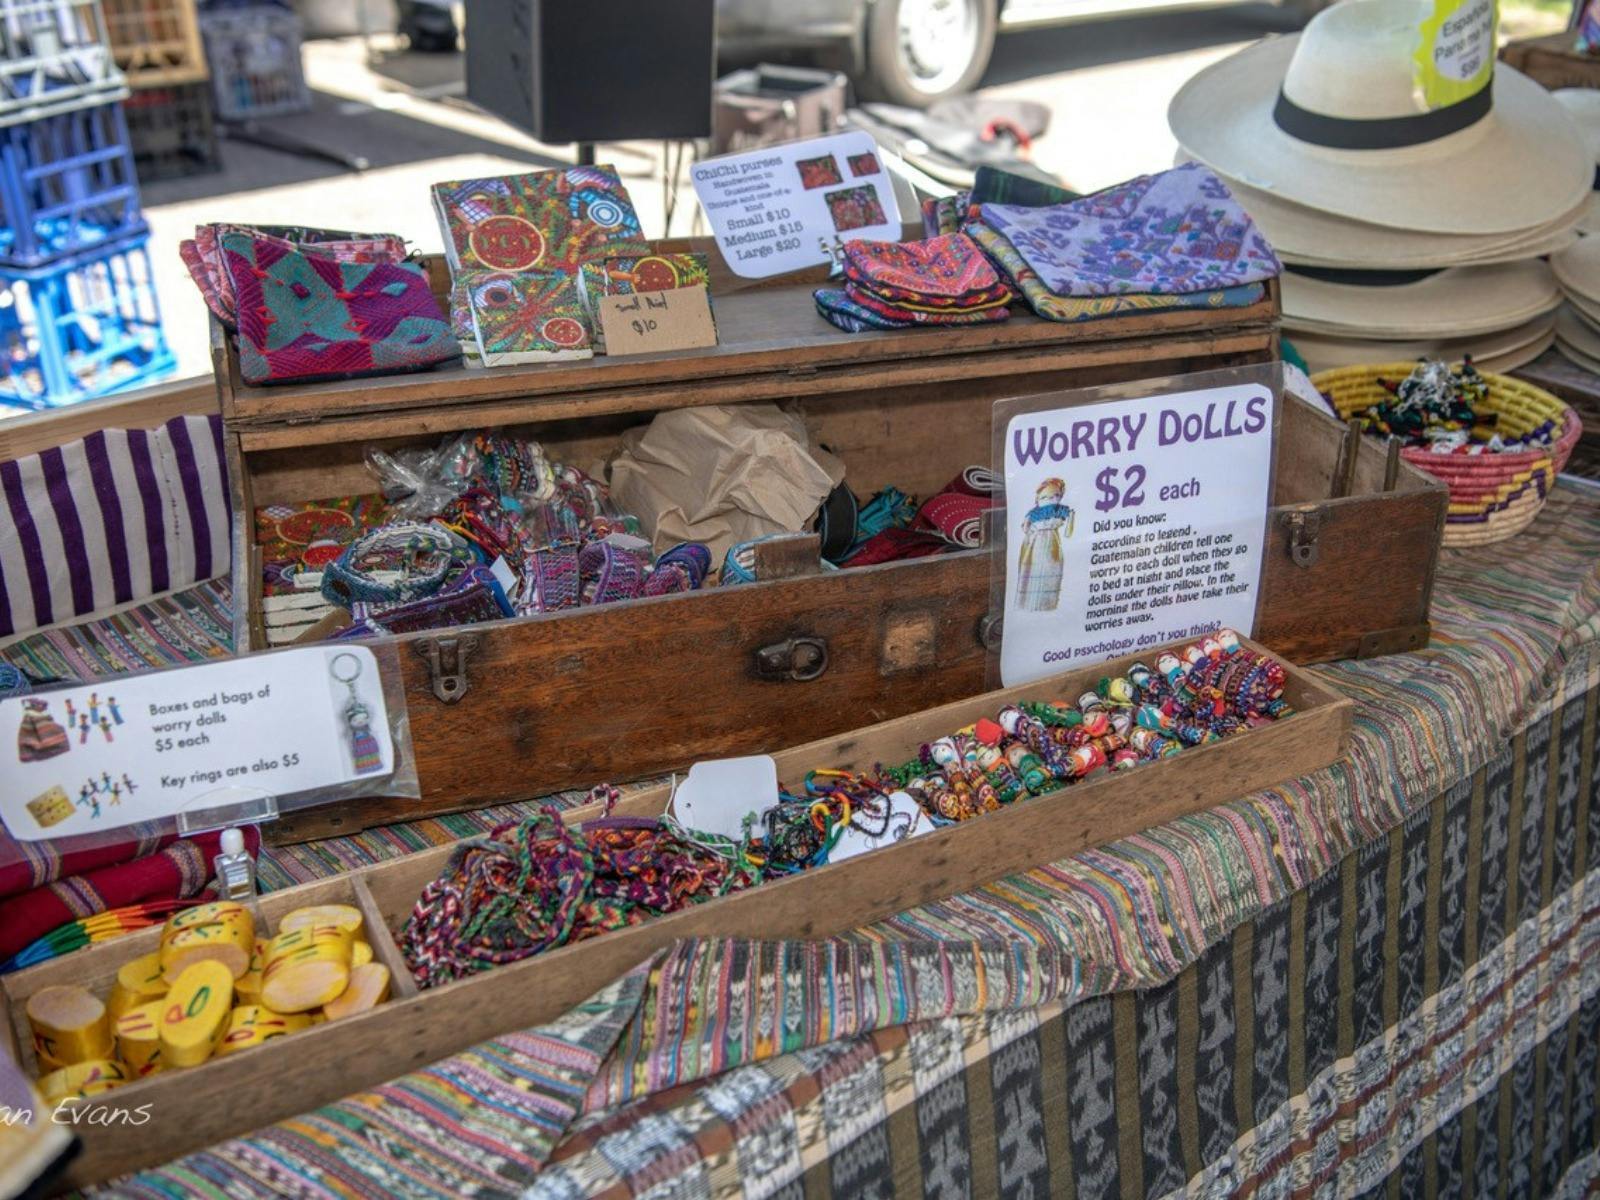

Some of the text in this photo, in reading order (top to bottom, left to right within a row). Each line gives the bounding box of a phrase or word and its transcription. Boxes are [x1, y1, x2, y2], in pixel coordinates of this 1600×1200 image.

[696, 156, 783, 181] ChiChi purses
[724, 183, 770, 196] Guatemala
[740, 194, 756, 204] and
[726, 208, 790, 230] Small $10
[744, 202, 765, 212] kind
[723, 220, 804, 247] Medium $15
[736, 237, 801, 260] Large $20
[1094, 464, 1200, 512] $2 each
[1093, 512, 1166, 534] Did you know:
[1090, 533, 1233, 565] Guatemalan children tell one
[1092, 533, 1142, 552] according
[1144, 530, 1155, 542] to
[1090, 544, 1248, 579] worry to each doll when they go
[1088, 572, 1236, 606] dolls under their pillow. In the
[1089, 560, 1230, 593] to bed at night and place the
[1086, 582, 1250, 620] morning the dolls have take their
[1085, 612, 1154, 632] worries away.
[1042, 647, 1071, 663] Good
[1074, 636, 1134, 658] psychology
[1137, 630, 1165, 646] don't
[1168, 627, 1186, 640] you
[1190, 620, 1222, 636] think?
[149, 684, 270, 716] Boxes and bags of
[152, 711, 226, 733] worry dolls
[155, 732, 210, 752] $5 each
[161, 753, 300, 788] Key rings are also $5
